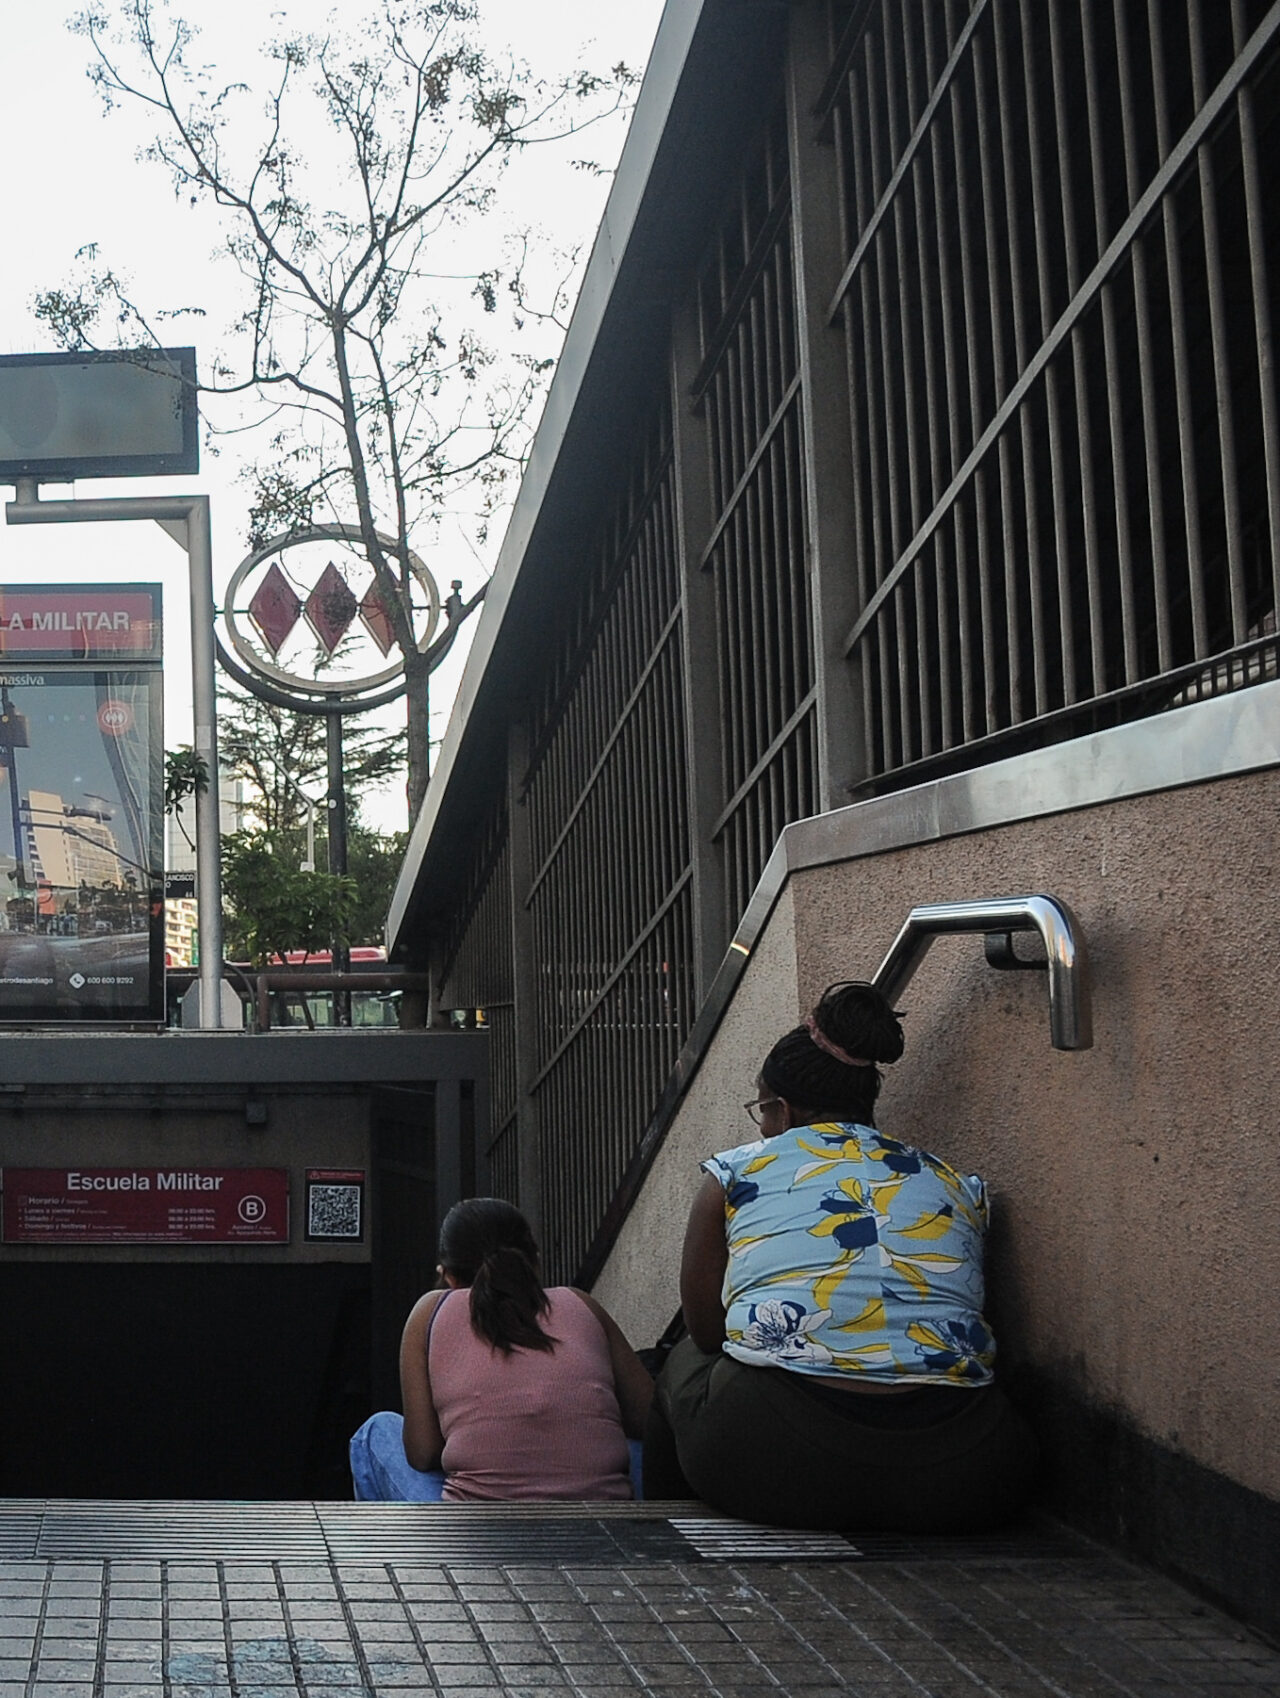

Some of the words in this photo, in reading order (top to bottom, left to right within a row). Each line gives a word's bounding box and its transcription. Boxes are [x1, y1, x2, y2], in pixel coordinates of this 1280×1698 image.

[32, 611, 130, 631] MILITAR
[86, 976, 101, 985] 600
[67, 1172, 150, 1190] Escuela
[156, 1172, 225, 1191] Militar
[28, 1196, 60, 1206] Horario
[245, 1201, 259, 1217] B
